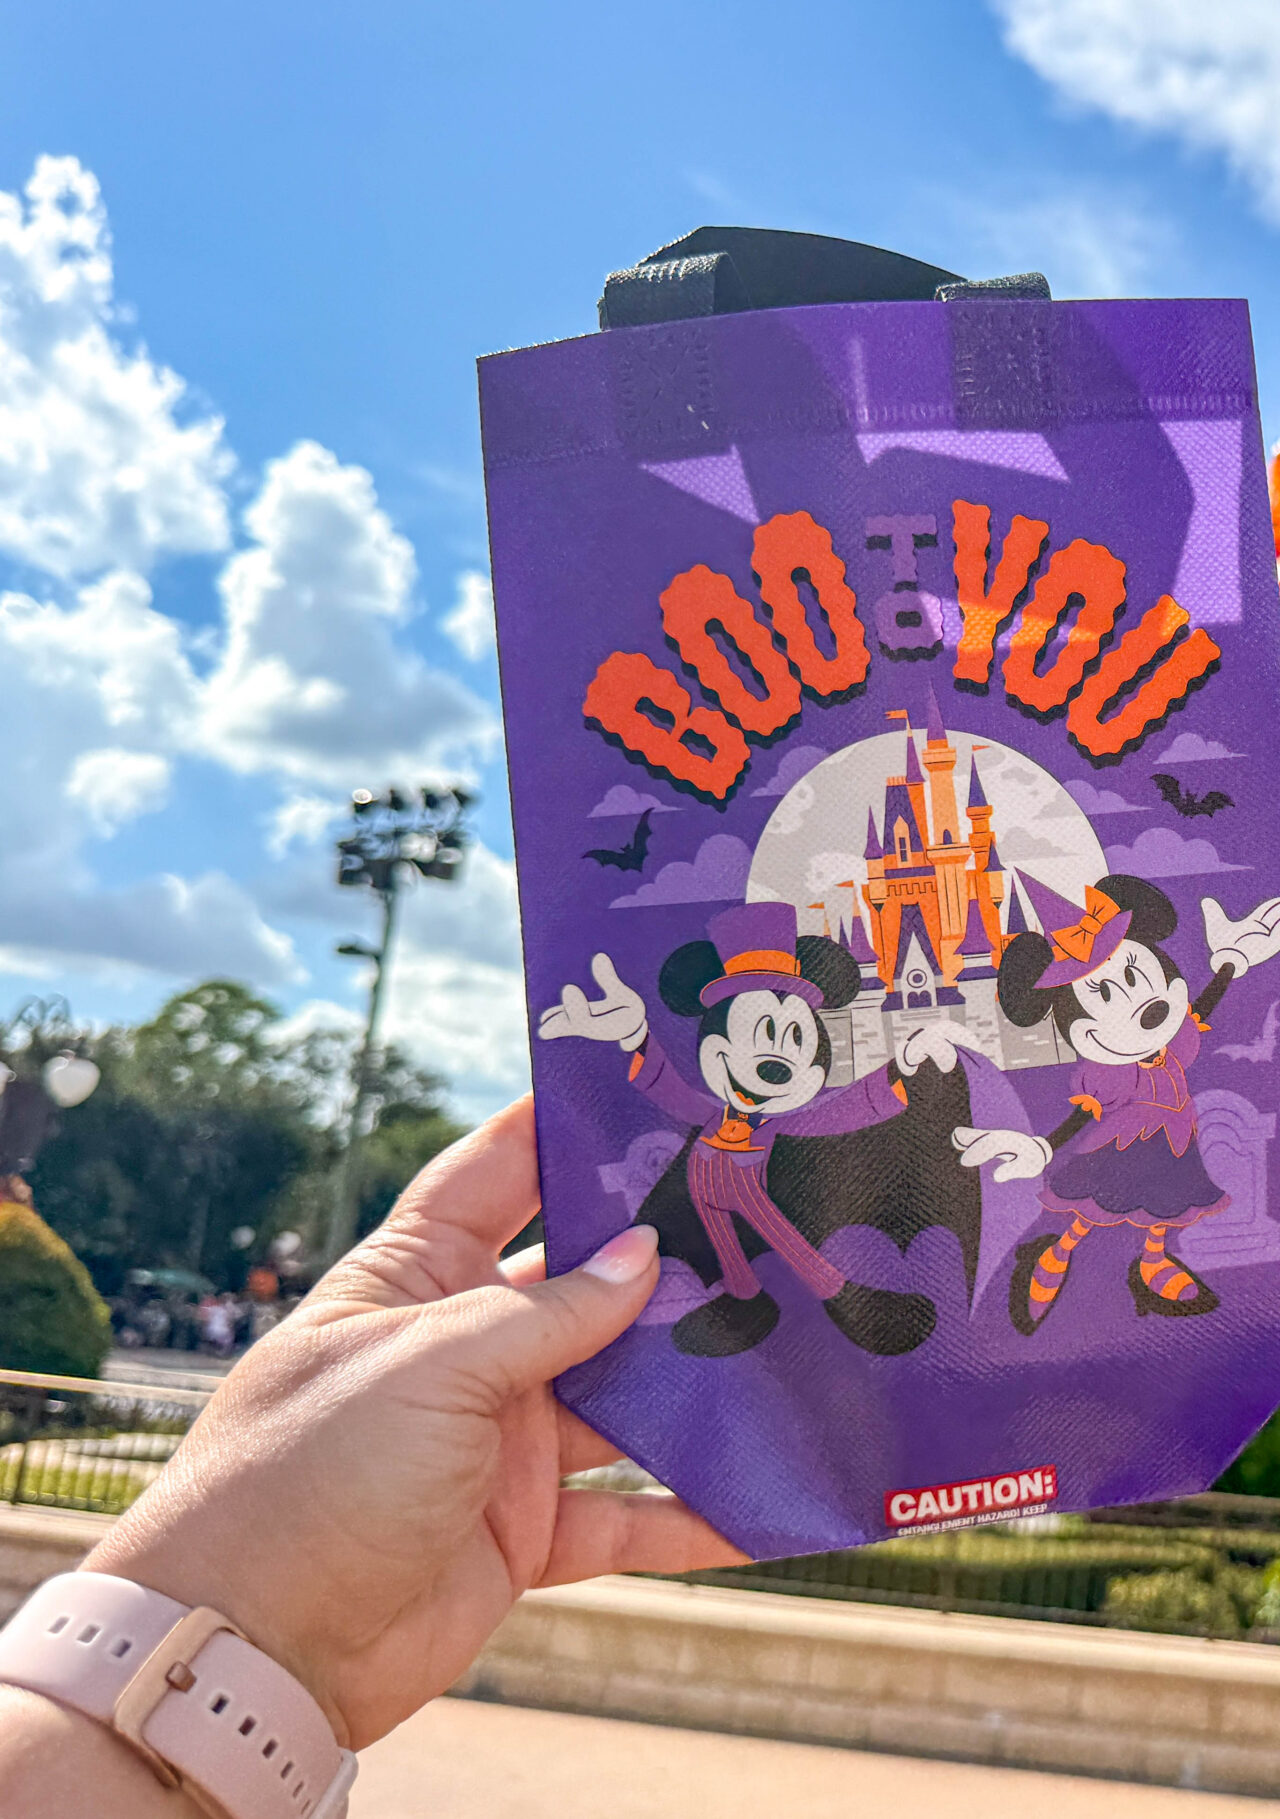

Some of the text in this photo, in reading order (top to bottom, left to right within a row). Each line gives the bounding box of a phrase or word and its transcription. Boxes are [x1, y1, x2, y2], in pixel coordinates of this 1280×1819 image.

[583, 510, 871, 807] BOO
[952, 499, 1221, 766] YOU
[890, 1471, 1054, 1522] CAUTION:
[1022, 1503, 1048, 1516] KEEP
